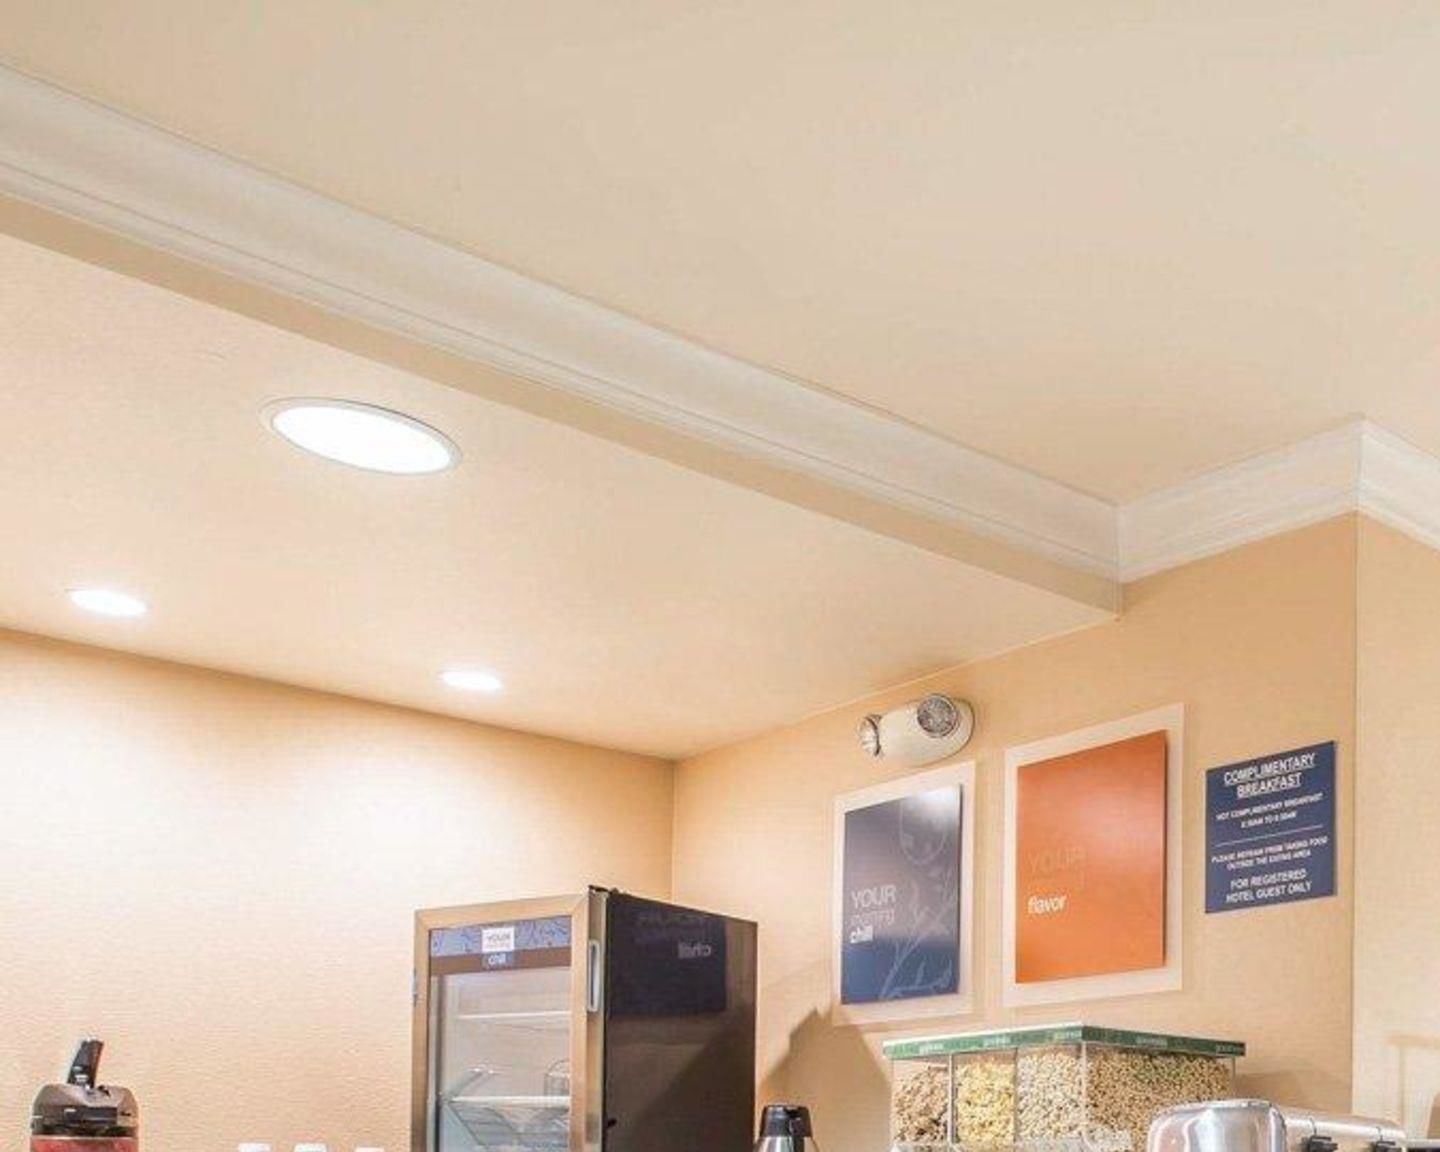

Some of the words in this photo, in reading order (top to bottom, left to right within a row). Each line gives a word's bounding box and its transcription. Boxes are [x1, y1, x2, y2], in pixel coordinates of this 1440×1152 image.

[1224, 752, 1316, 786] COMPLIMENTARY
[1237, 772, 1302, 799] BREAKFAST
[1230, 878, 1249, 890] FOR
[1251, 868, 1307, 886] REGISTERED
[851, 884, 897, 909] YOUR
[1226, 890, 1255, 903] HOTEL
[1256, 885, 1286, 899] GUEST
[1287, 881, 1313, 894] ONLY
[1027, 895, 1067, 915] flavor
